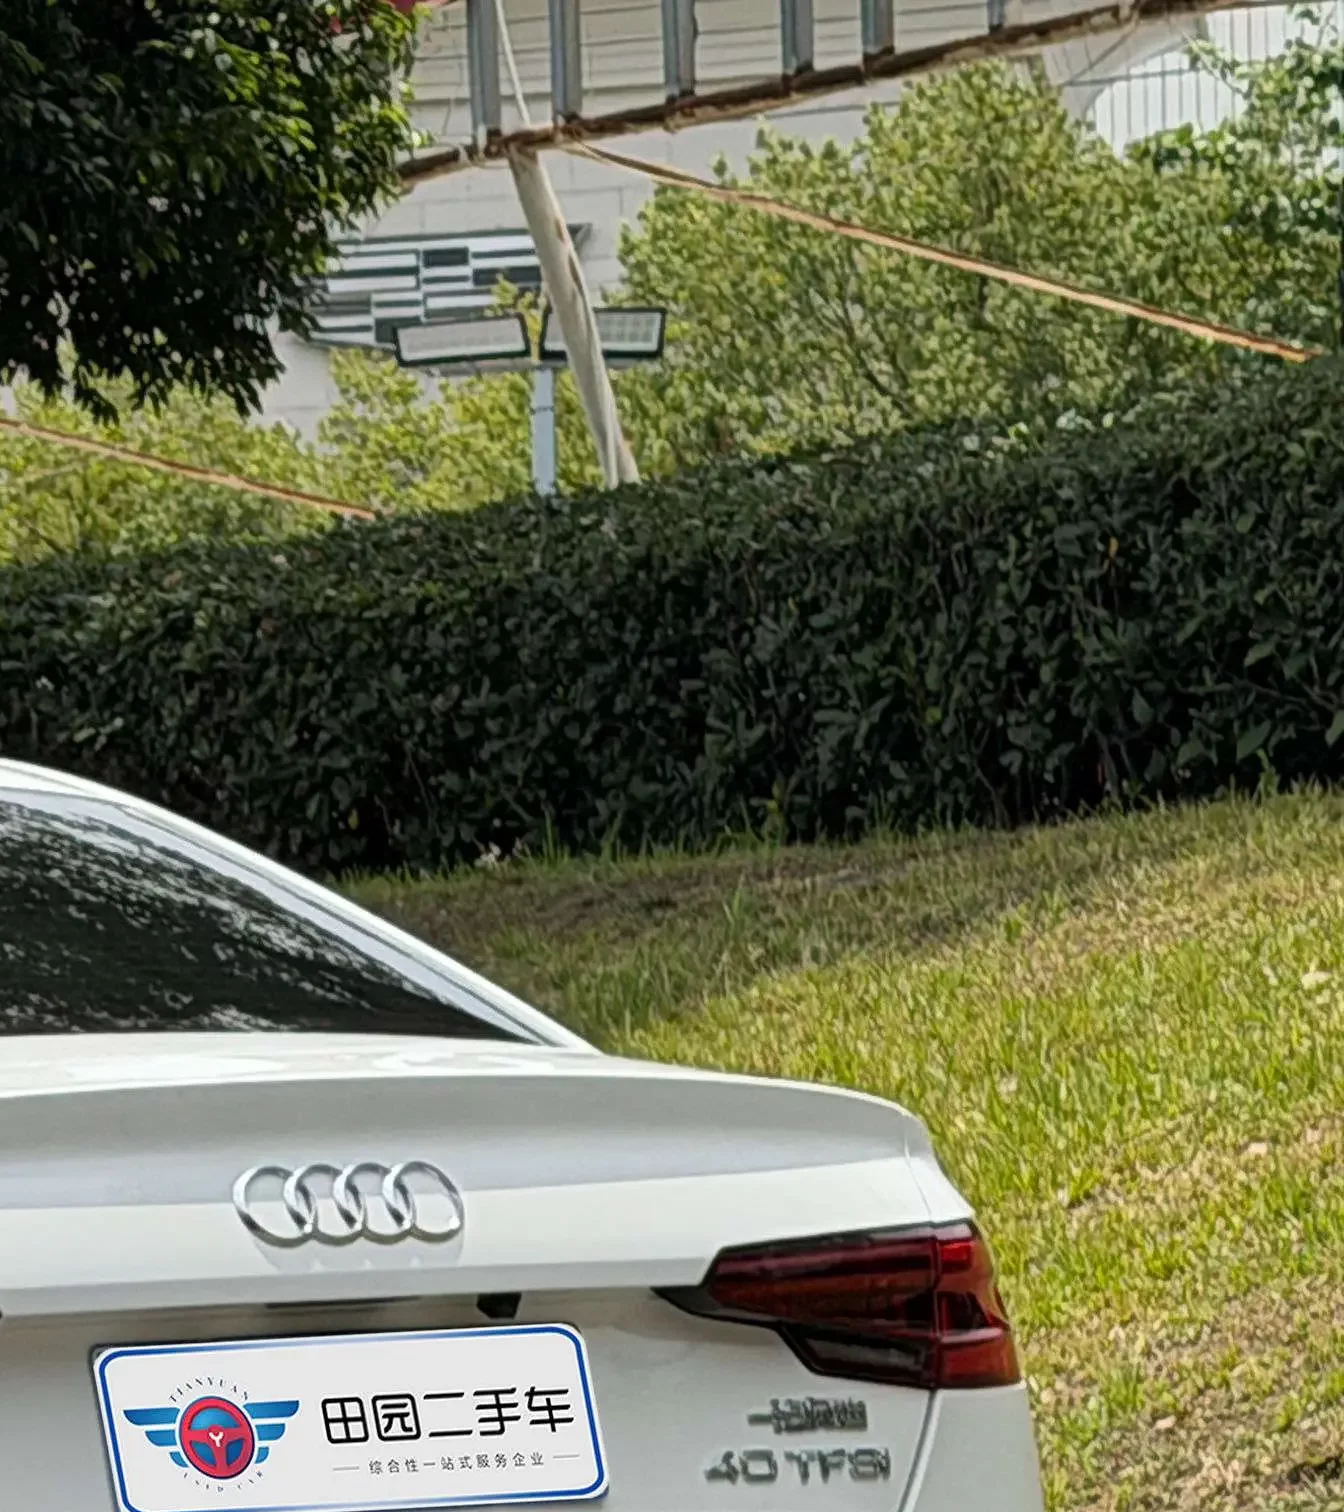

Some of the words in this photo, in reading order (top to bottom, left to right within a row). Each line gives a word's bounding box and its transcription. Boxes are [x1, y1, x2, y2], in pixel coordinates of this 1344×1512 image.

[320, 1386, 575, 1444] 田园二手车
[368, 1452, 544, 1475] 综合性一站式服务企业
[703, 1449, 778, 1485] 40
[783, 1448, 891, 1485] TFSI
